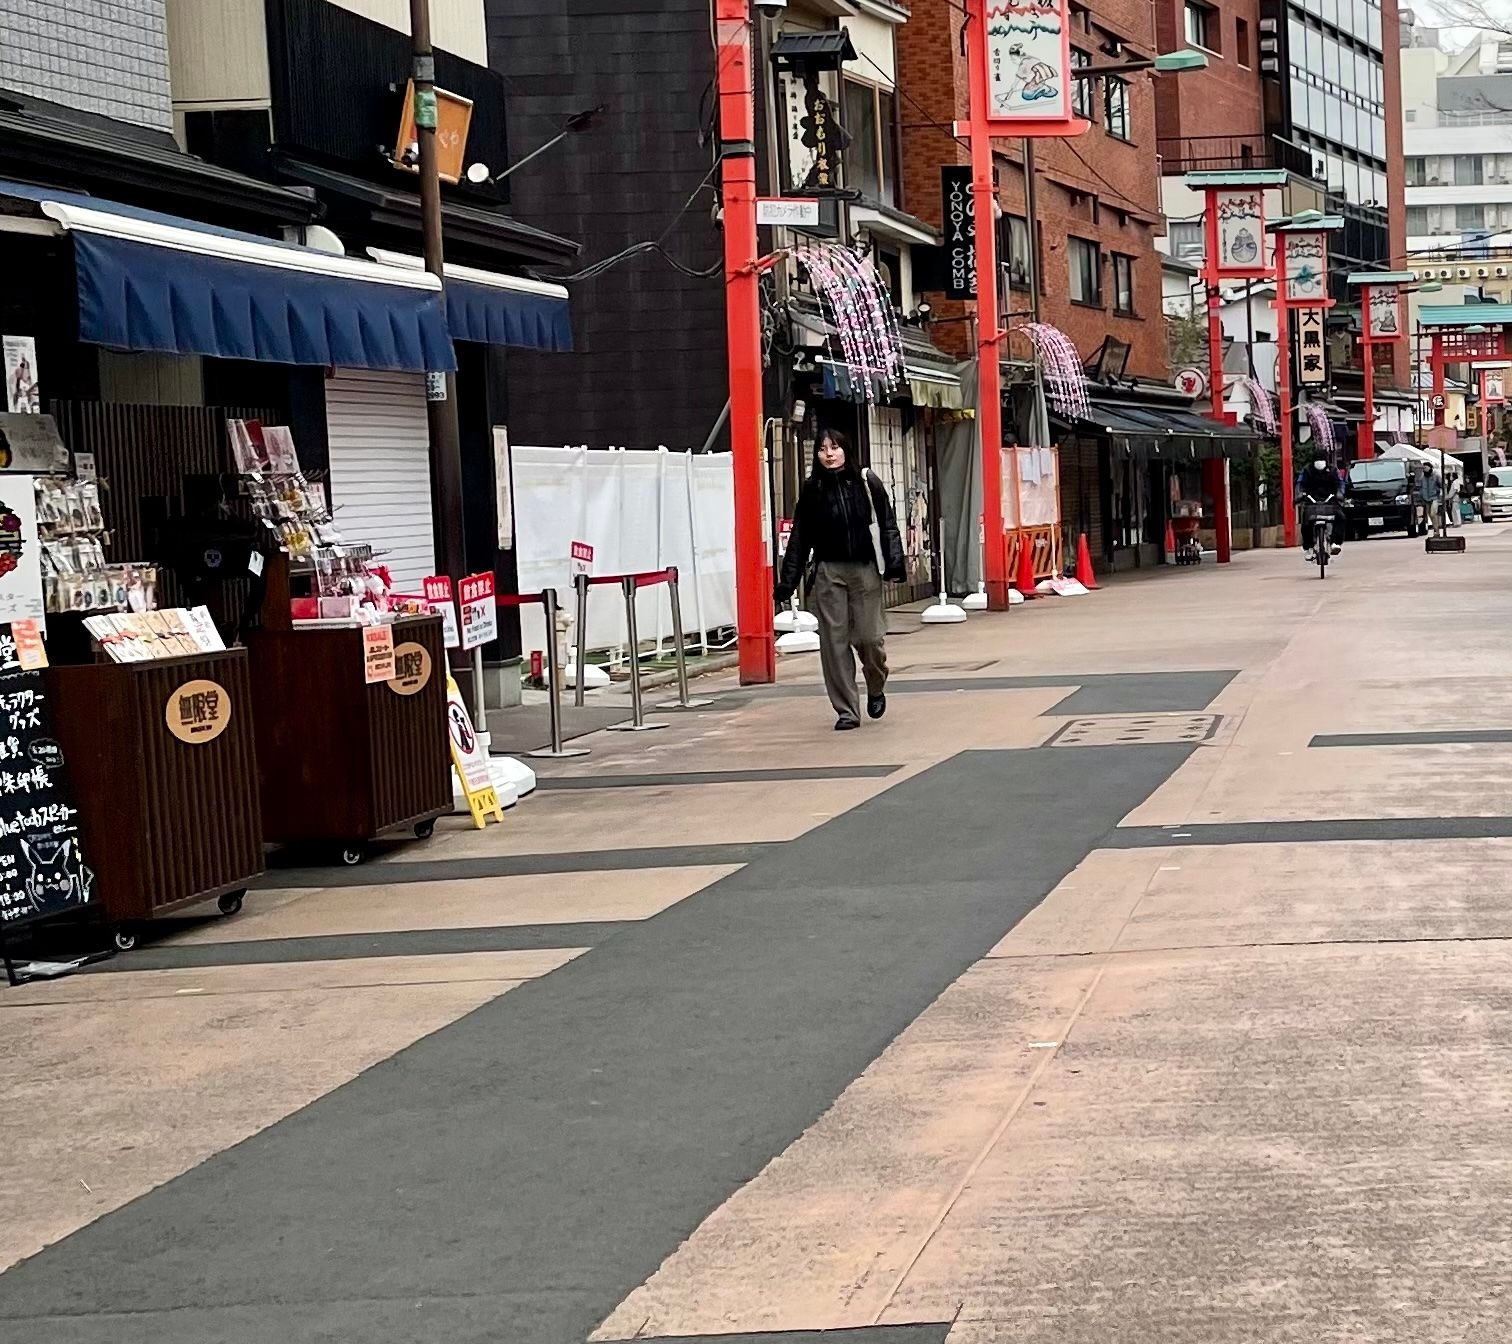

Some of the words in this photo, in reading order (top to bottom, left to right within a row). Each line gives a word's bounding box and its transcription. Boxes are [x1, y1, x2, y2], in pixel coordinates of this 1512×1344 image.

[950, 181, 965, 242] YONOYA
[951, 247, 965, 290] COMB
[1302, 308, 1323, 373] 大黒家
